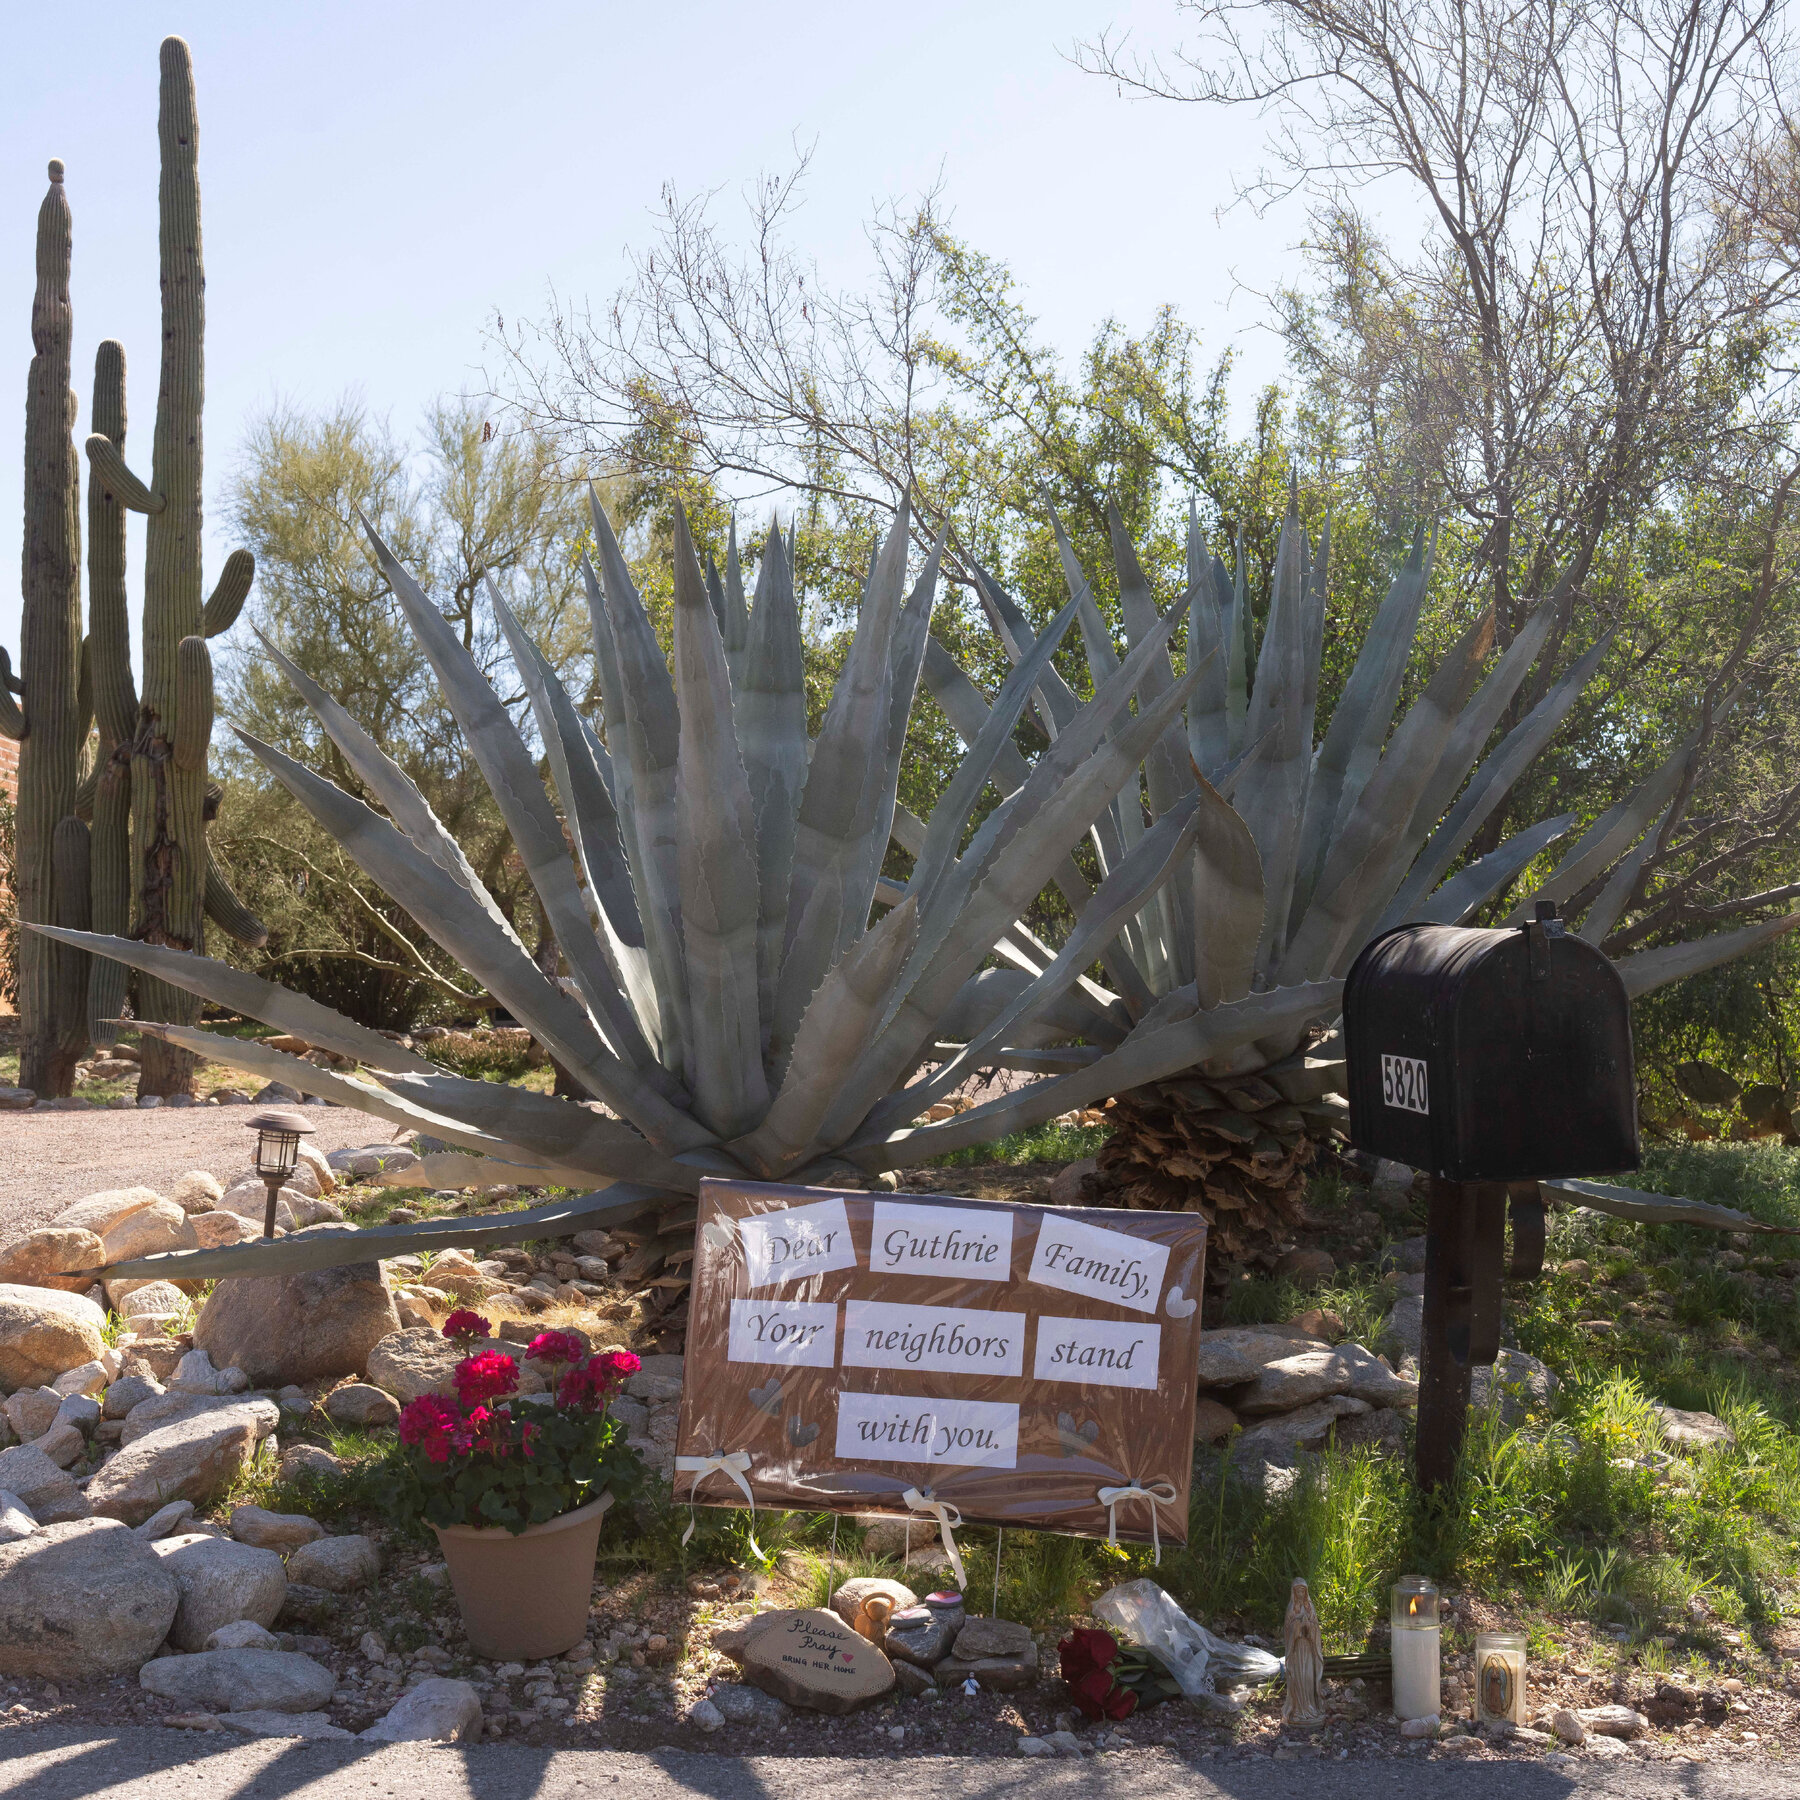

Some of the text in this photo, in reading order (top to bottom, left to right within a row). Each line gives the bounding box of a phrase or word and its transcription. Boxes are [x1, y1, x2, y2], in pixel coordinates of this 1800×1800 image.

[1385, 1057, 1427, 1111] 5820
[769, 1229, 1151, 1301] Dear Guthrie Family,
[747, 1312, 1144, 1370] Your neighbors stand
[857, 1413, 1001, 1457] with you.
[787, 1618, 849, 1640] Please
[798, 1635, 842, 1660] Pray
[782, 1654, 856, 1675] BRING HER HOME
